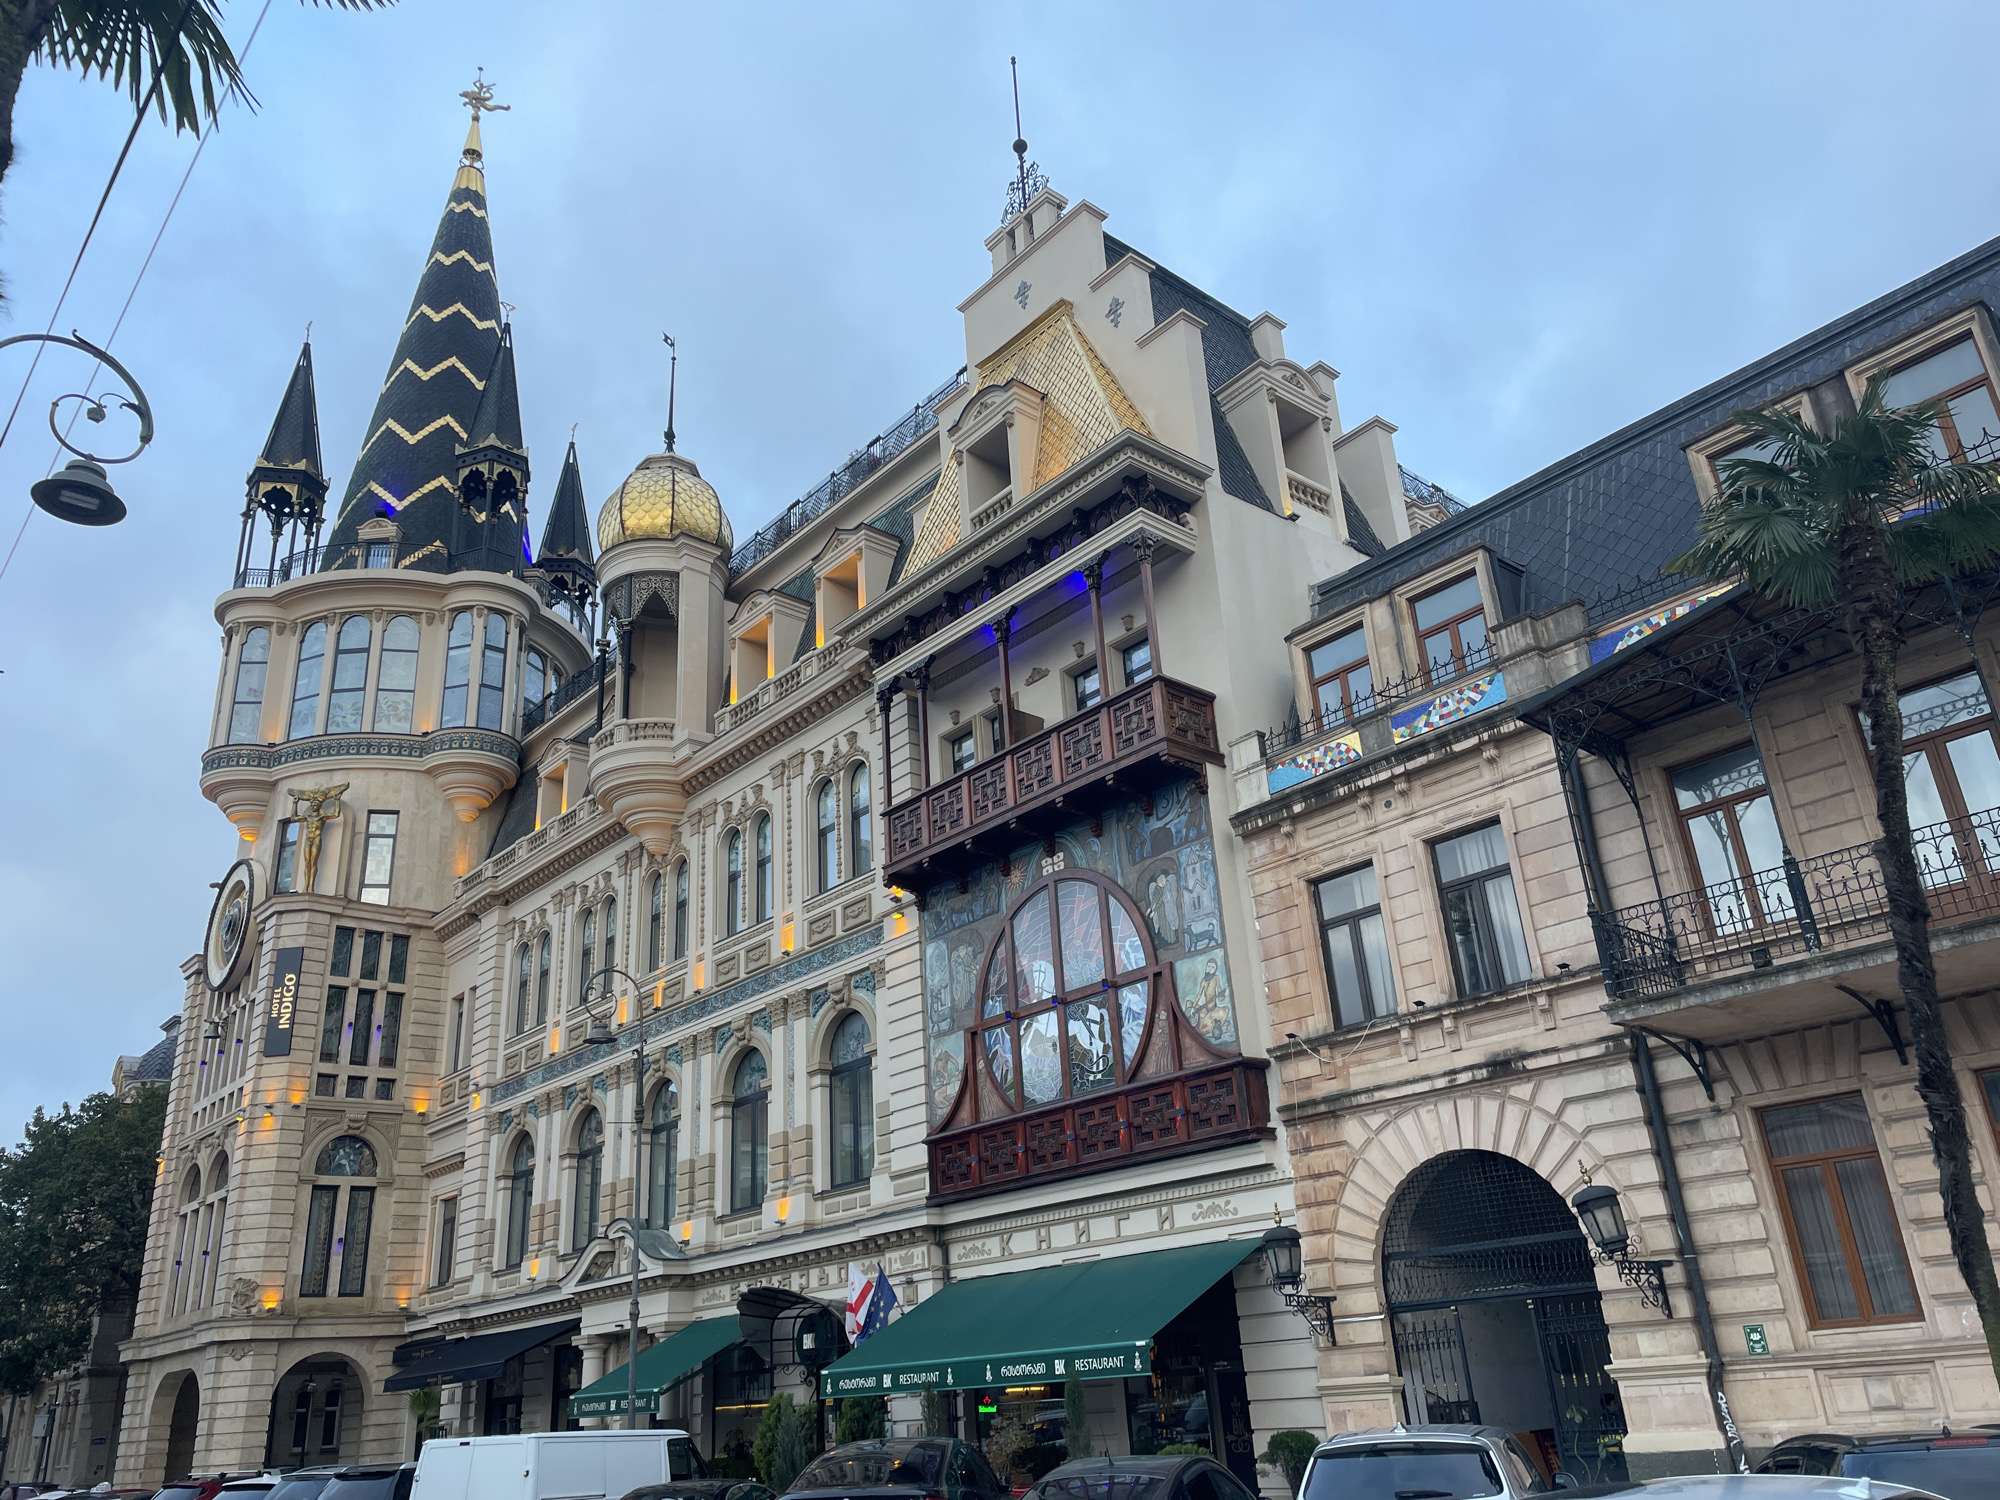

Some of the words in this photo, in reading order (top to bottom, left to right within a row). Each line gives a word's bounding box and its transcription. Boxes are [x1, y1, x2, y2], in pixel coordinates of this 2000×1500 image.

[270, 986, 282, 1018] HOTEL
[278, 973, 297, 1029] INDIGO
[999, 1204, 1175, 1257] КНИГИ
[803, 1333, 816, 1350] BK
[1054, 1359, 1066, 1375] BK
[1075, 1355, 1125, 1371] RESTAURANT
[883, 1374, 893, 1388] BK
[899, 1371, 940, 1385] RESTAURANT
